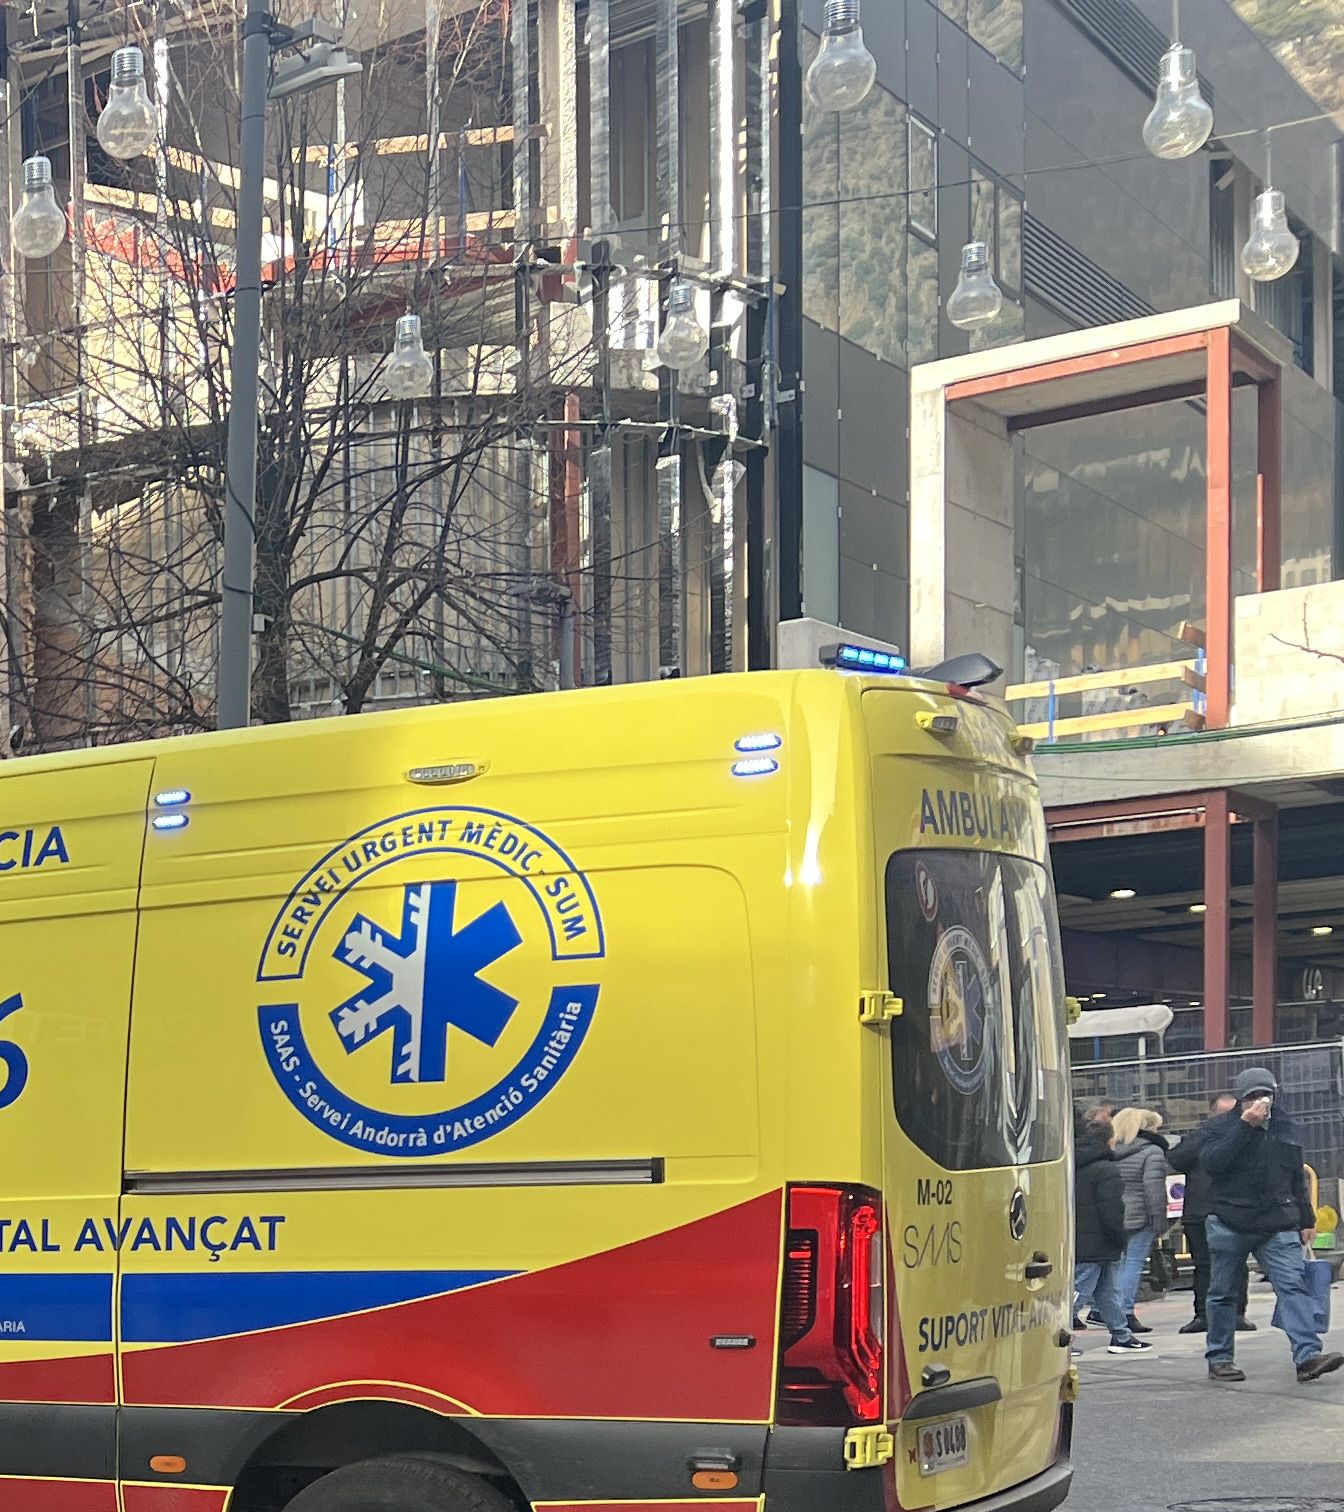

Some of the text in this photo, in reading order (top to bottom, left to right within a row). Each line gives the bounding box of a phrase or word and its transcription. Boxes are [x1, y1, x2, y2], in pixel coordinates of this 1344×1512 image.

[277, 868, 342, 958] SERVEI
[342, 819, 453, 873] URGENT
[458, 821, 542, 873] MÈDIC
[546, 876, 588, 941] SUM
[270, 1019, 301, 1074] SAAS
[298, 1080, 351, 1131] Servei
[349, 1119, 428, 1149] Andorrà
[432, 1086, 524, 1146] d'Atenció
[520, 1000, 582, 1094] Sanitària
[917, 1178, 953, 1206] M-02
[73, 1215, 286, 1262] AVANÇAT
[918, 1308, 988, 1353] SUPORT
